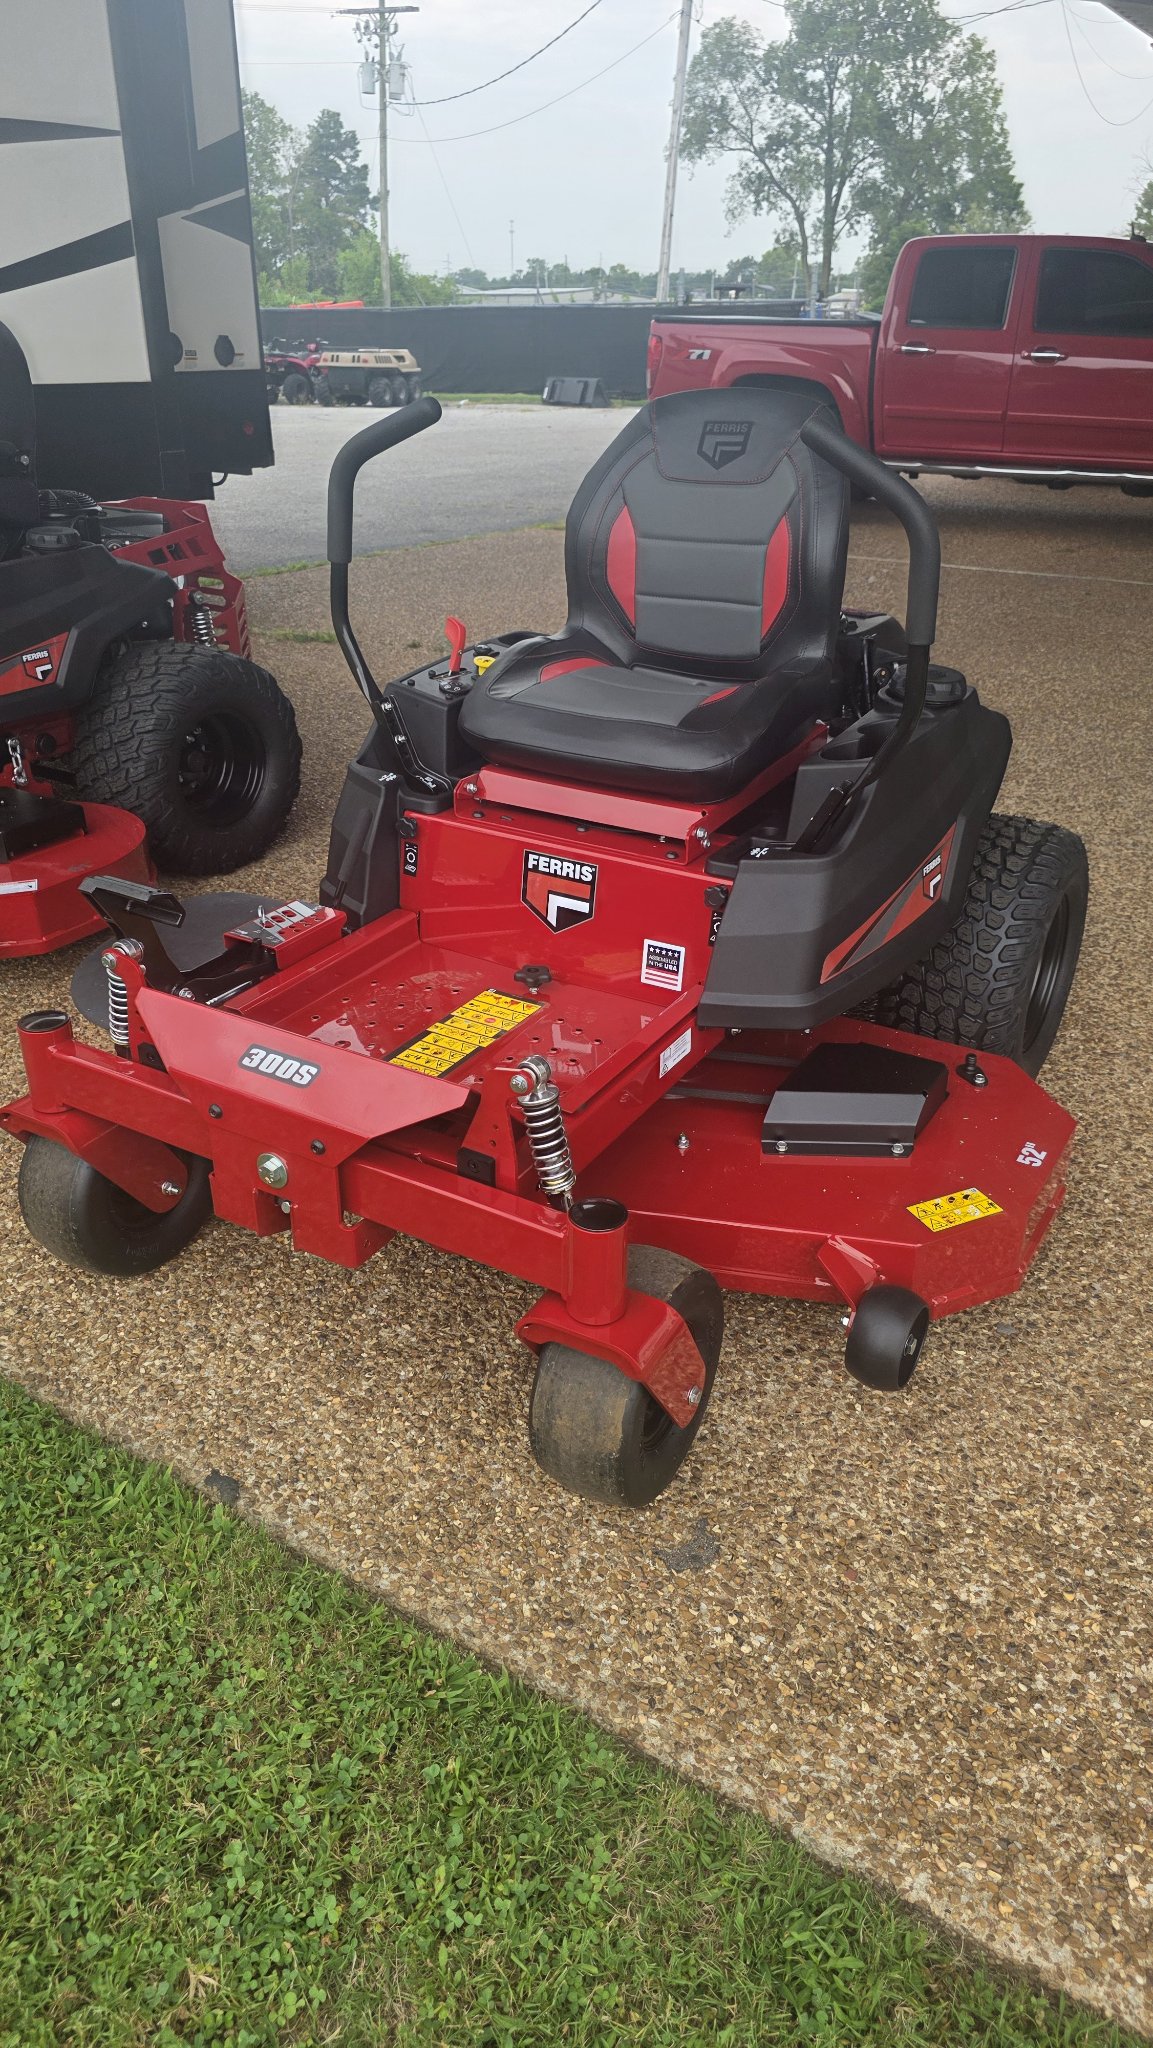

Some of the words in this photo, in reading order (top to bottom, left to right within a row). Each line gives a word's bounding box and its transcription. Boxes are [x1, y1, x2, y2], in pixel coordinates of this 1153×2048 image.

[705, 423, 749, 433] FERRIS
[22, 650, 49, 663] FERRIS
[527, 853, 594, 882] FERRIS
[923, 854, 941, 876] FERRIS
[664, 963, 678, 972] USA
[241, 1048, 318, 1085] 300S
